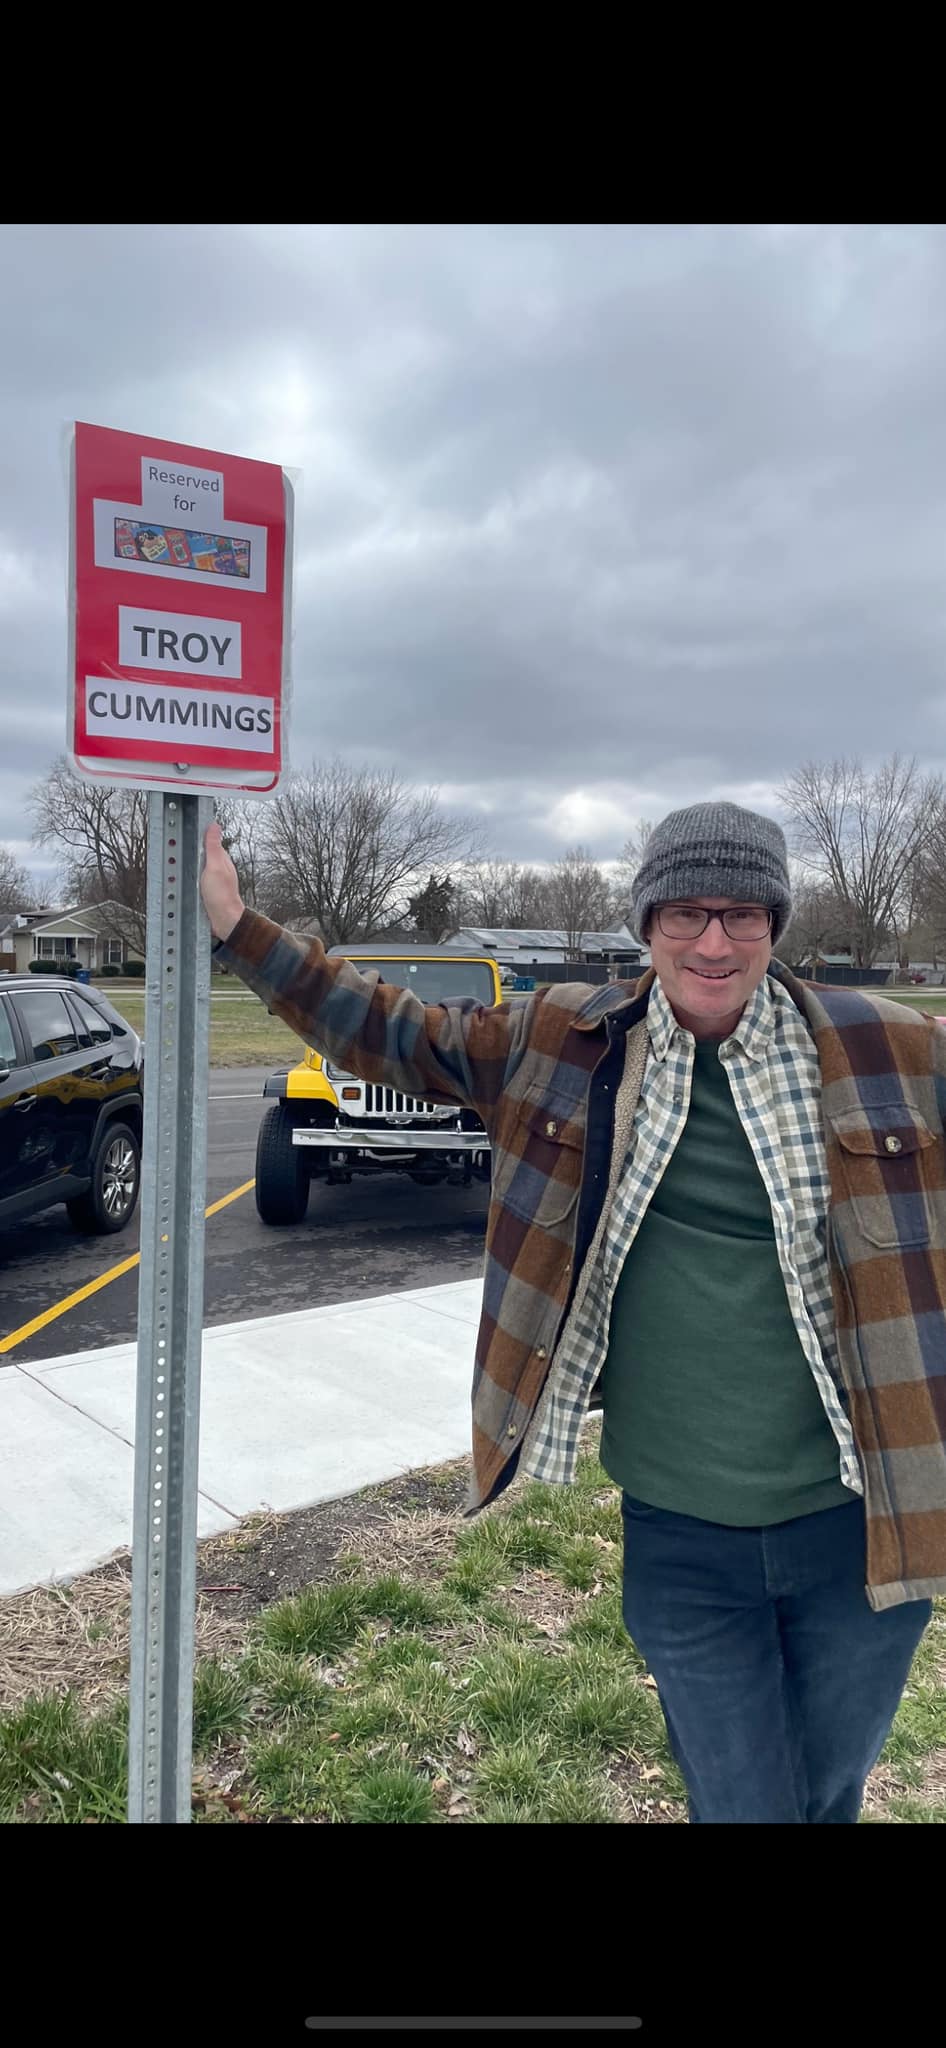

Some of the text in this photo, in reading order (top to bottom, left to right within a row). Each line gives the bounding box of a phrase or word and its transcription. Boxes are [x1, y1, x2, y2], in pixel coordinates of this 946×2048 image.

[148, 466, 220, 493] Reserved
[173, 494, 196, 513] for
[133, 625, 232, 666] TROY
[88, 691, 272, 734] CUMMINGS
